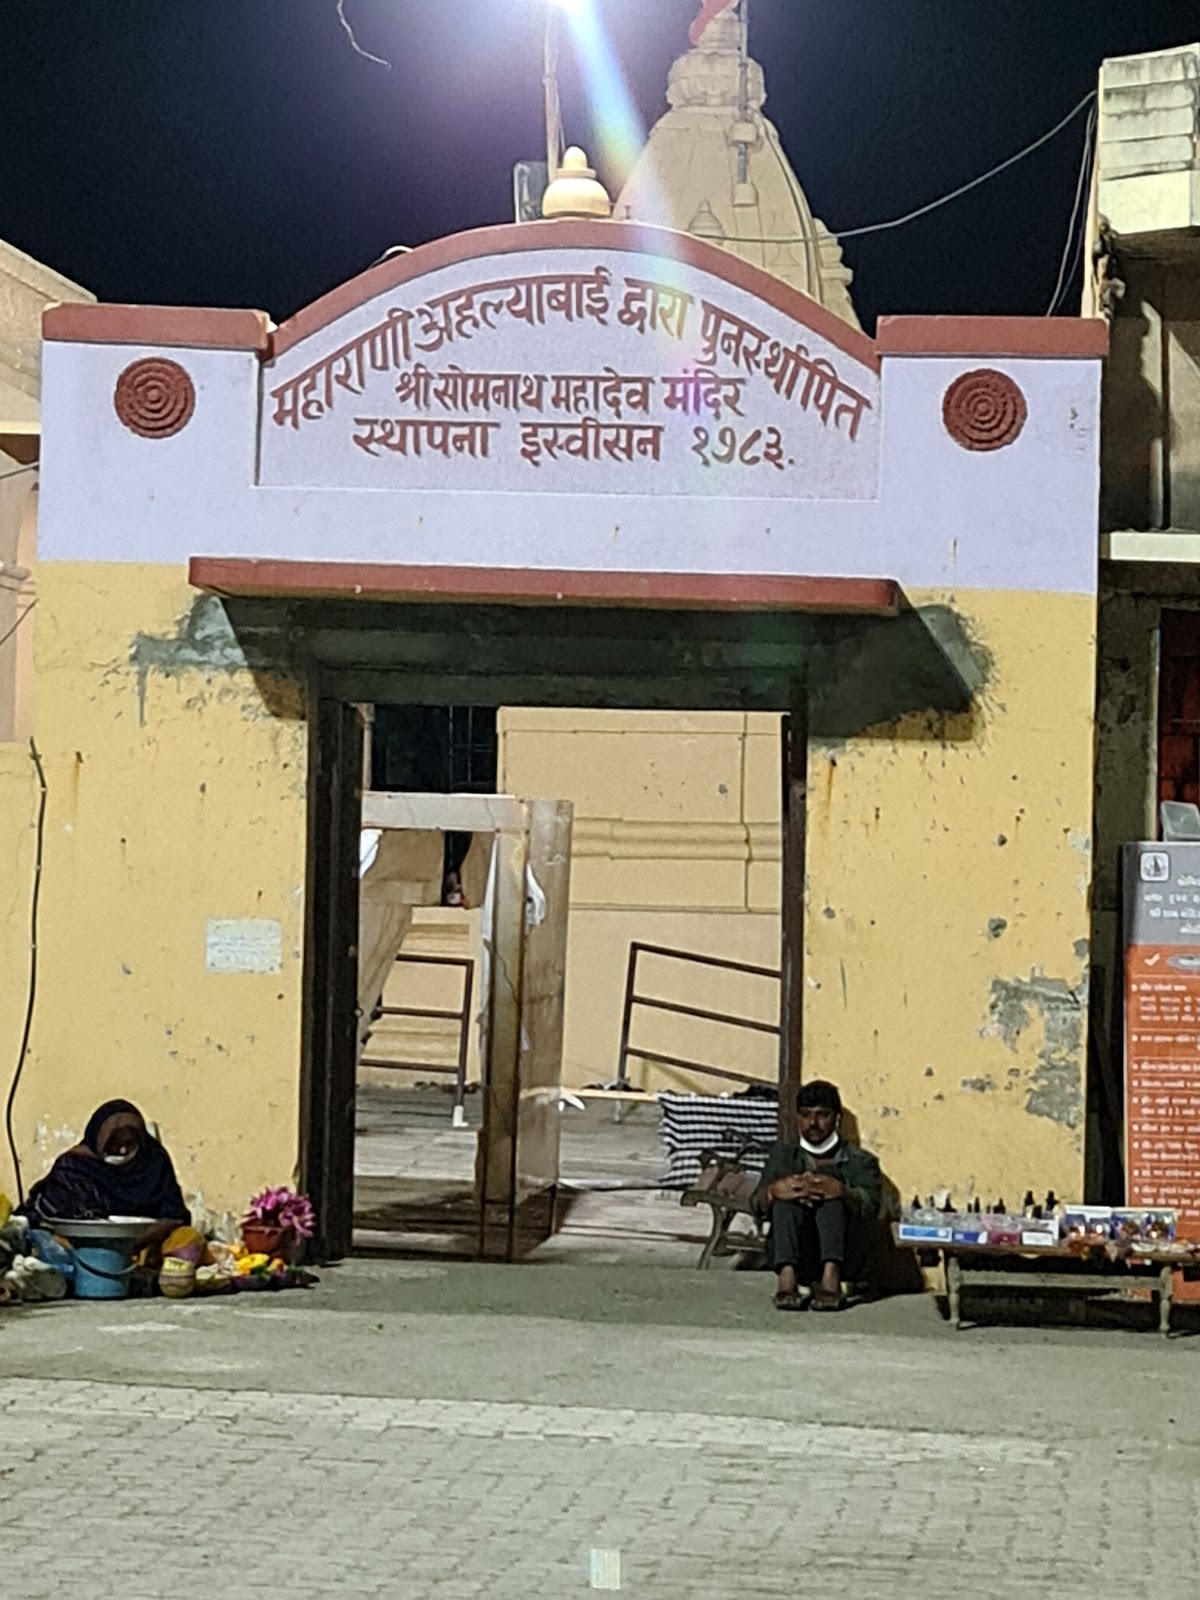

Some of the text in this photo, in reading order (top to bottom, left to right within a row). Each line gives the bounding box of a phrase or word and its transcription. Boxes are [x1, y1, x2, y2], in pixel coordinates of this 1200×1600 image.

[270, 307, 415, 430] महाराणी
[414, 265, 612, 352] अहल्याबाई
[617, 276, 695, 340] द्वारा
[551, 366, 655, 419] महादेव
[661, 367, 746, 420] मंदिर
[353, 417, 501, 458] स्थापना
[519, 416, 664, 467] इस्वीसन
